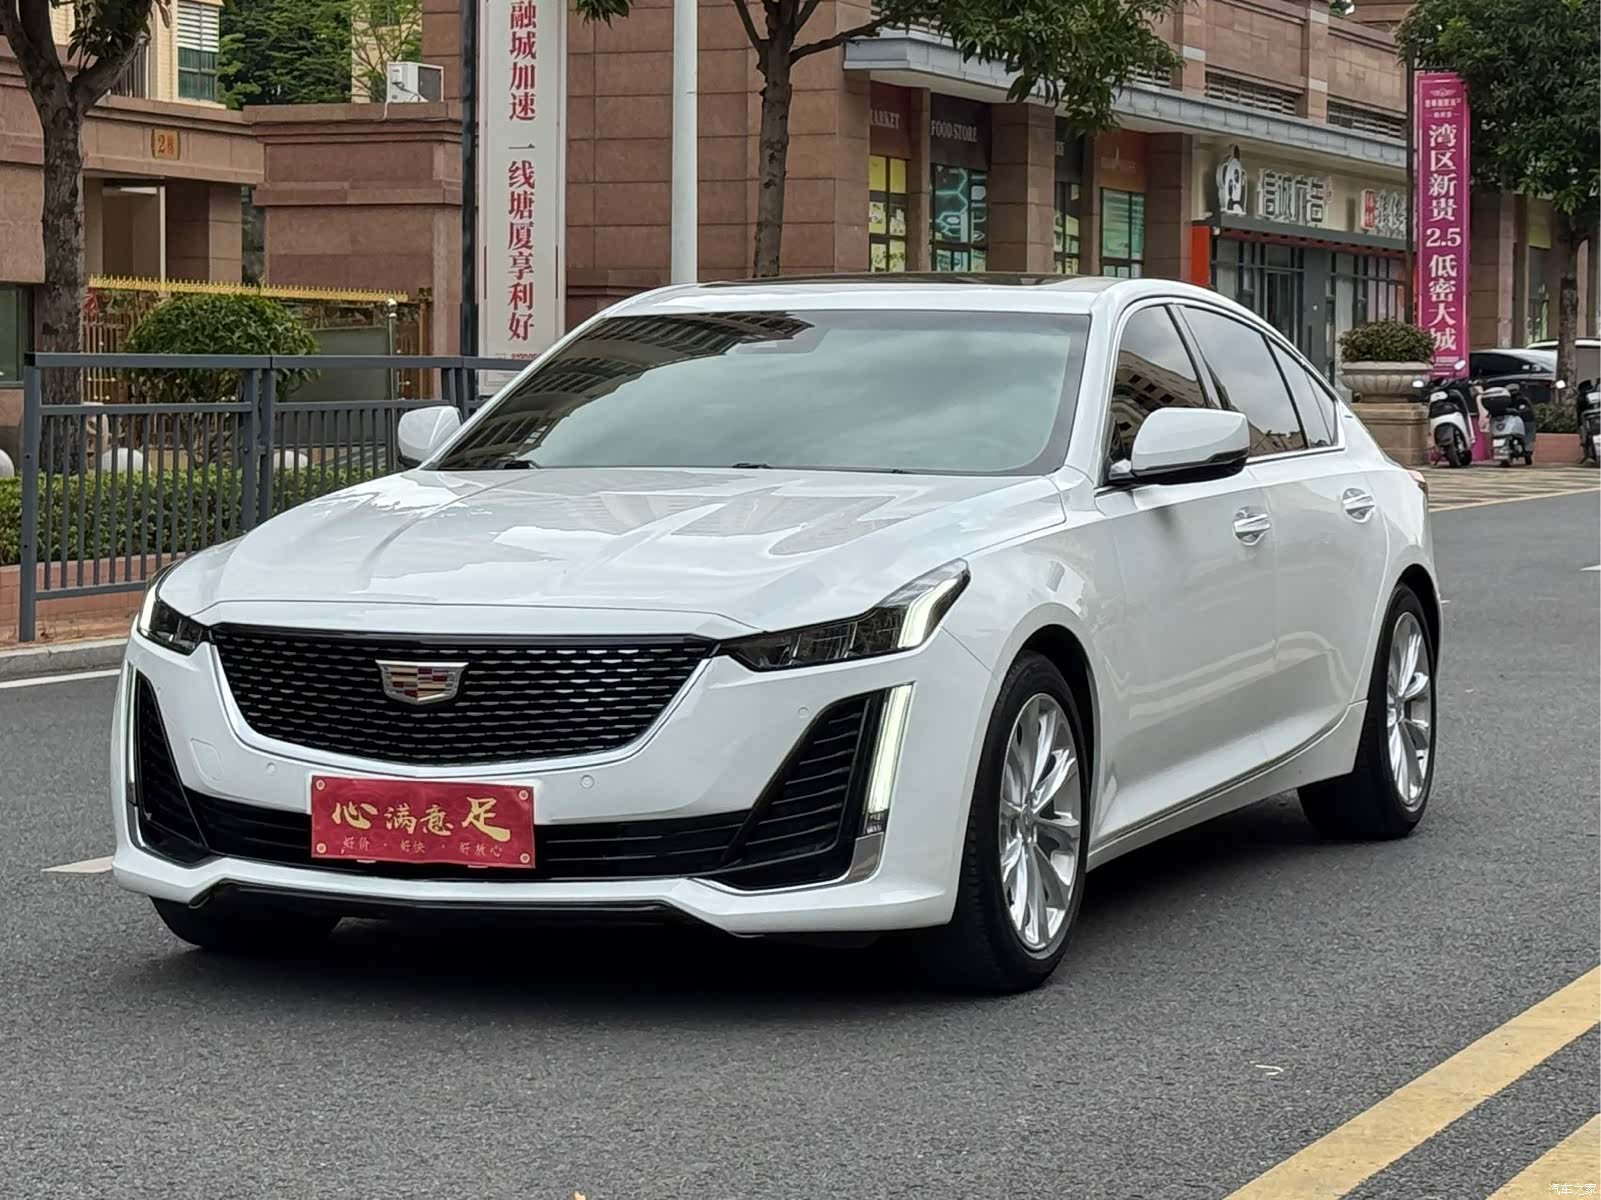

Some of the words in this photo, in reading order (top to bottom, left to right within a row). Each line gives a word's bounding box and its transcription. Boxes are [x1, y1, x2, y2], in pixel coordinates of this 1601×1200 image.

[508, 1, 537, 121] 融城加速
[1255, 168, 1327, 227] 信诚广告
[508, 144, 535, 341] 一线塘厦享利好
[331, 796, 511, 842] 心满意足
